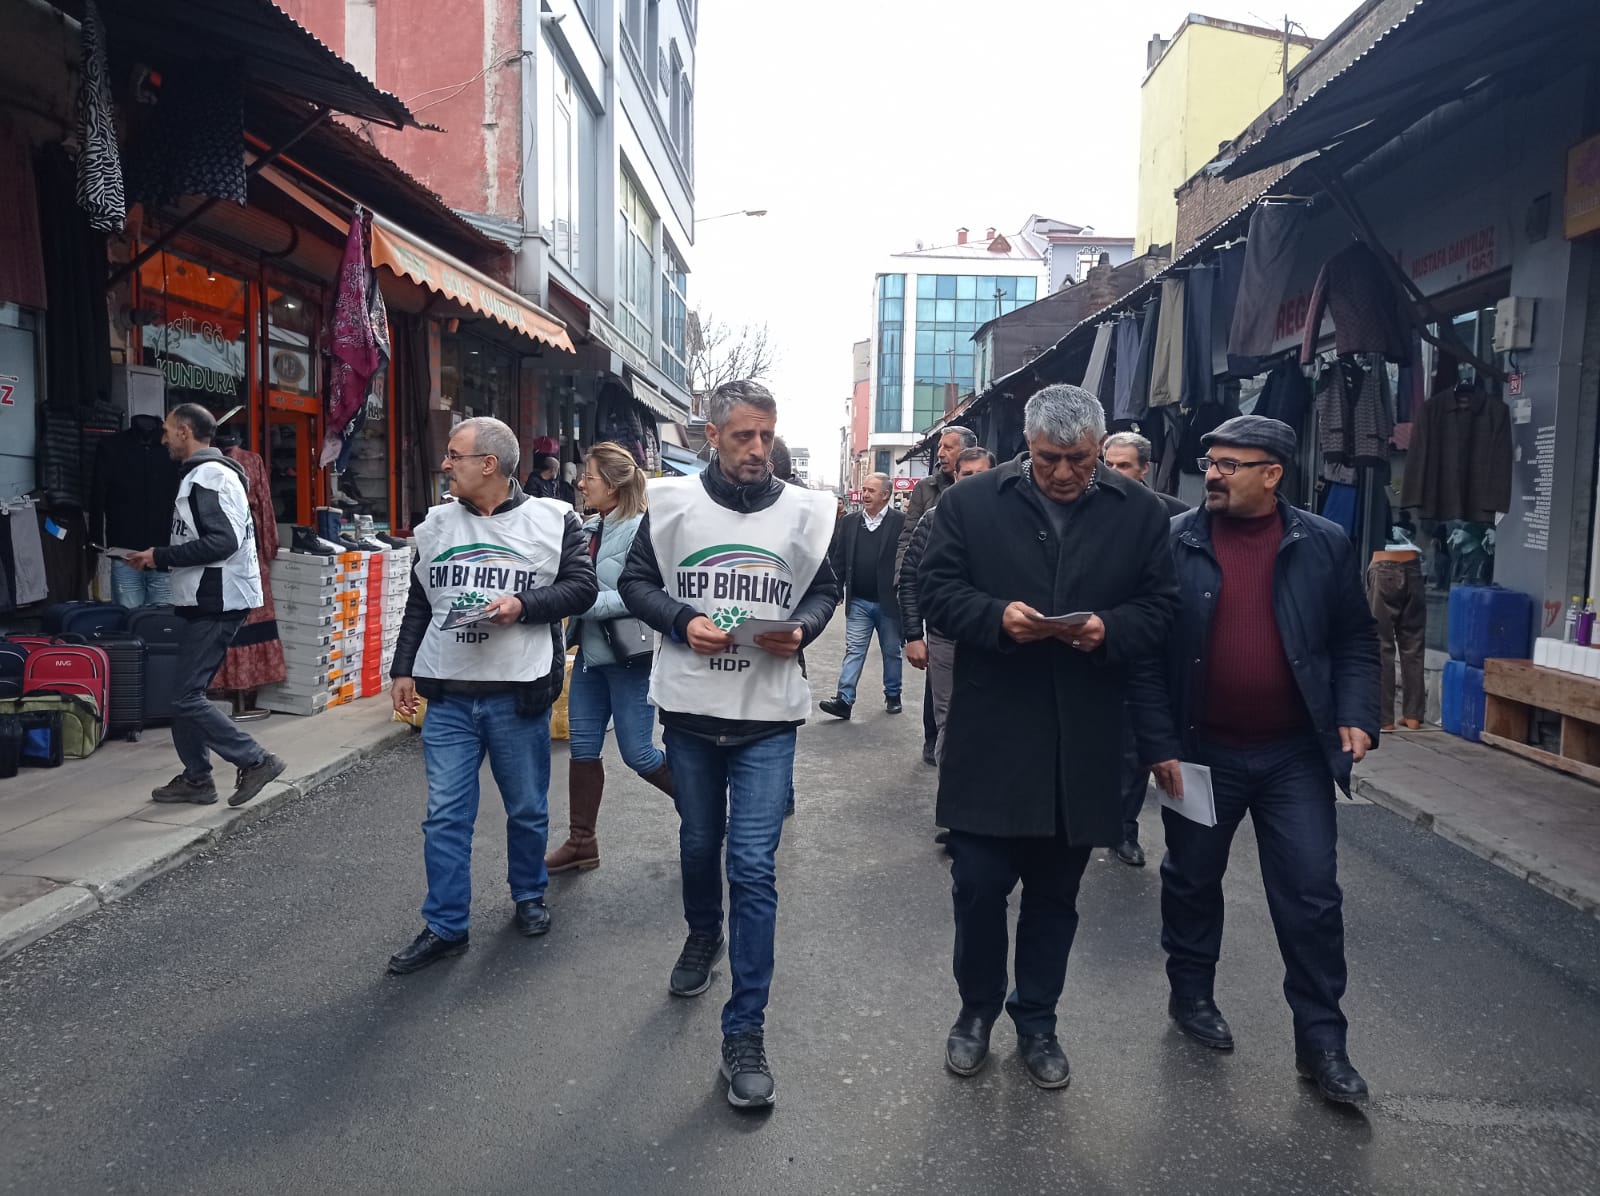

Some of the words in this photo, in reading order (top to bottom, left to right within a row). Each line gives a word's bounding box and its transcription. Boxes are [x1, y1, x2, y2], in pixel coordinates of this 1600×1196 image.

[478, 287, 527, 330] KUNDURA
[157, 359, 236, 396] KUNDURA
[429, 565, 448, 588] EM
[452, 564, 470, 588] BI
[473, 567, 510, 590] HEV
[677, 571, 709, 599] HEP
[455, 632, 490, 644] HDP
[709, 657, 750, 672] HDP
